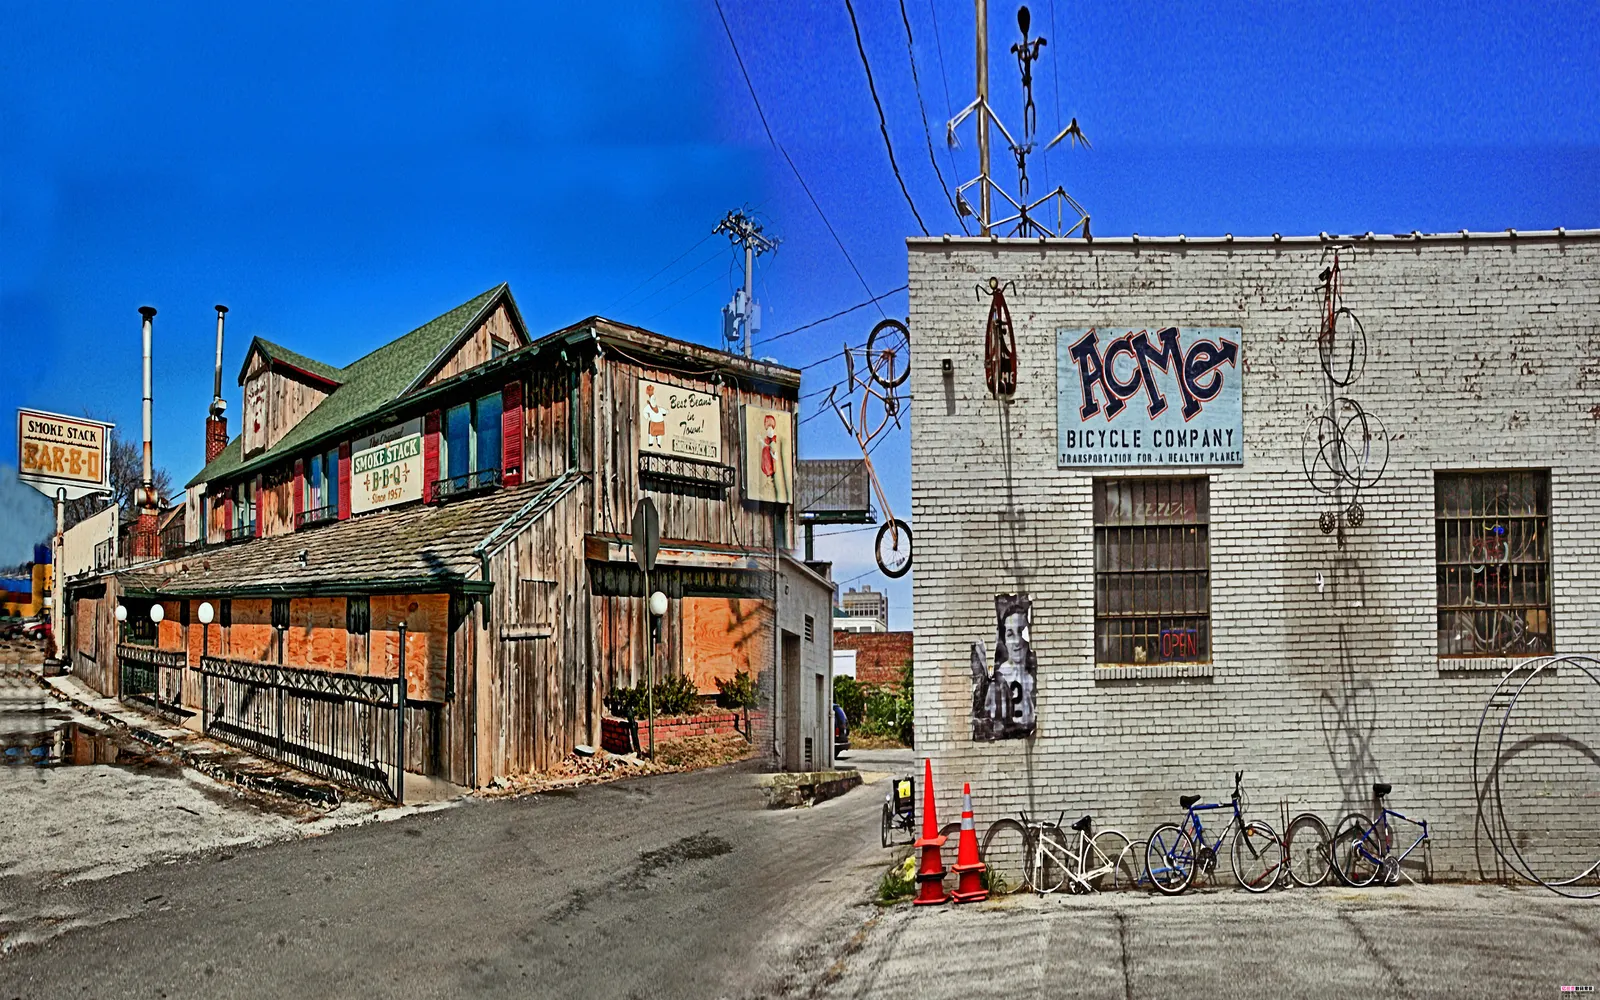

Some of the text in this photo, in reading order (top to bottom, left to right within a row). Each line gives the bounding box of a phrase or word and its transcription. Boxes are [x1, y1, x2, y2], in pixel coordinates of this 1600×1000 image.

[688, 393, 711, 408] Beans
[28, 420, 97, 442] SMOKE STACK
[1067, 428, 1234, 448] BICYCLE COMPANY
[355, 438, 418, 473] SMOKE STACK
[1062, 453, 1132, 463] TRANSPORTATION
[1137, 453, 1152, 463] FOR
[1168, 452, 1204, 463] HEALTHY
[372, 488, 402, 504] Since 1957
[1162, 633, 1197, 657] OPEN
